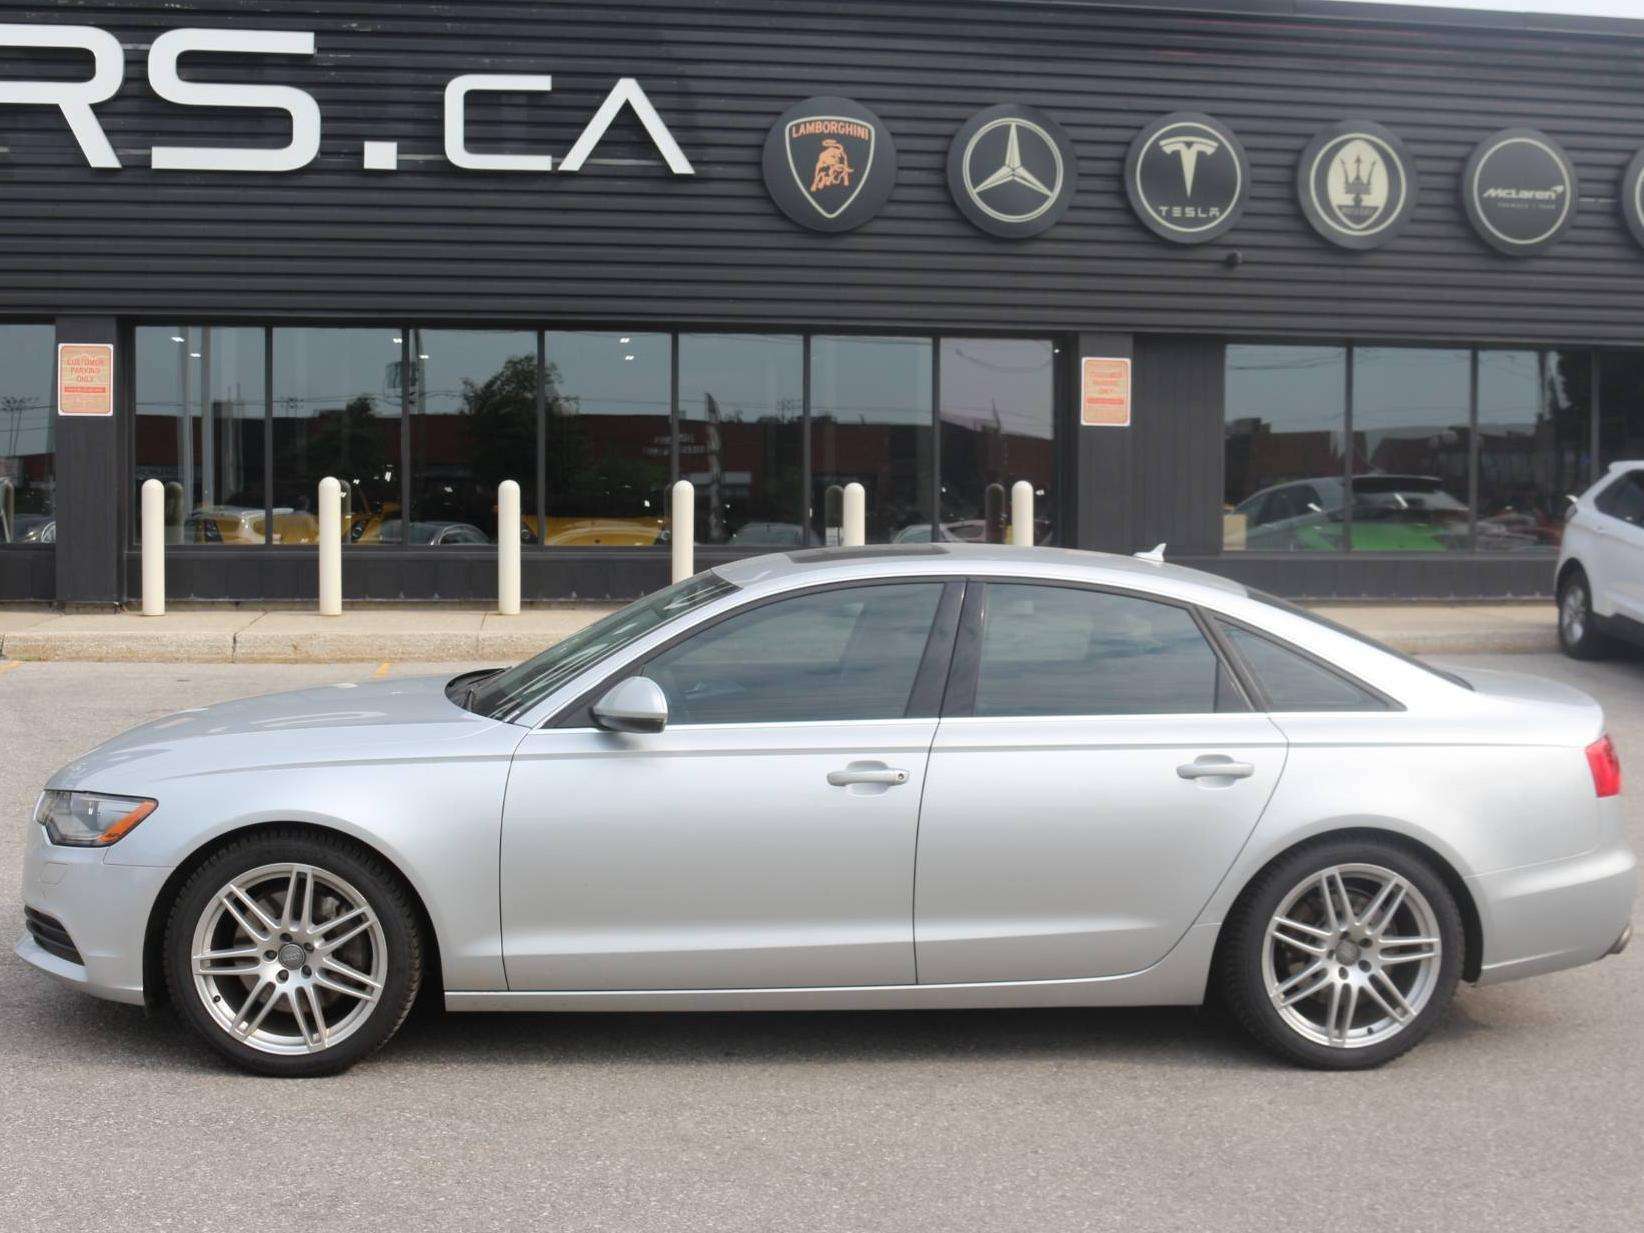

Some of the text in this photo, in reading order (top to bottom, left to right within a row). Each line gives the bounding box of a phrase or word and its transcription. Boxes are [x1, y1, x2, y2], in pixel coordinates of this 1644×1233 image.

[792, 120, 870, 141] LAMBORGHINI
[1158, 205, 1220, 218] TESLA
[70, 367, 101, 375] PARKING
[76, 375, 94, 383] ONLY
